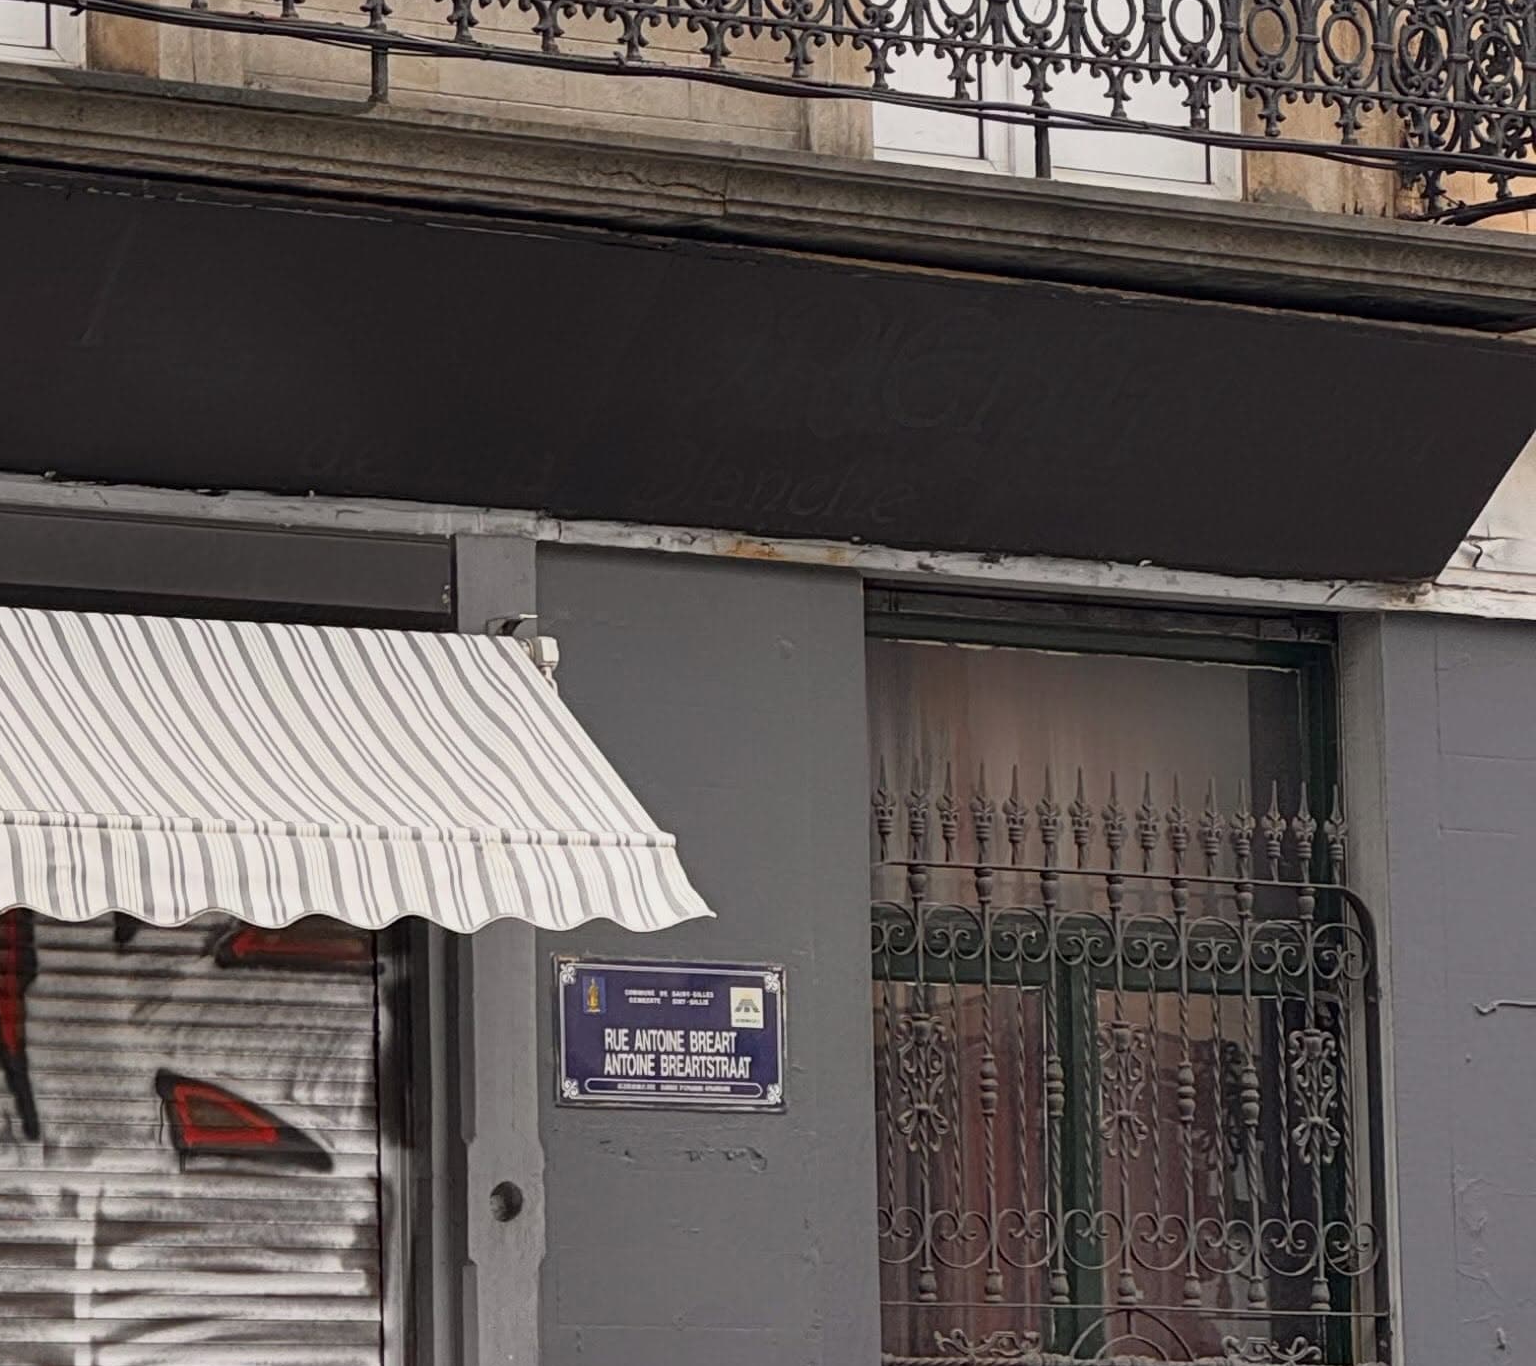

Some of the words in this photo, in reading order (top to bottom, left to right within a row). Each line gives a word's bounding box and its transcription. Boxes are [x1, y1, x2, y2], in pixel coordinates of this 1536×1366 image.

[605, 1028, 629, 1052] RUE
[634, 1029, 686, 1053] ANTOINE
[689, 1030, 737, 1054] BREART
[604, 1053, 656, 1077] ANTOINE
[660, 1055, 752, 1079] BREARTSTRAAT
